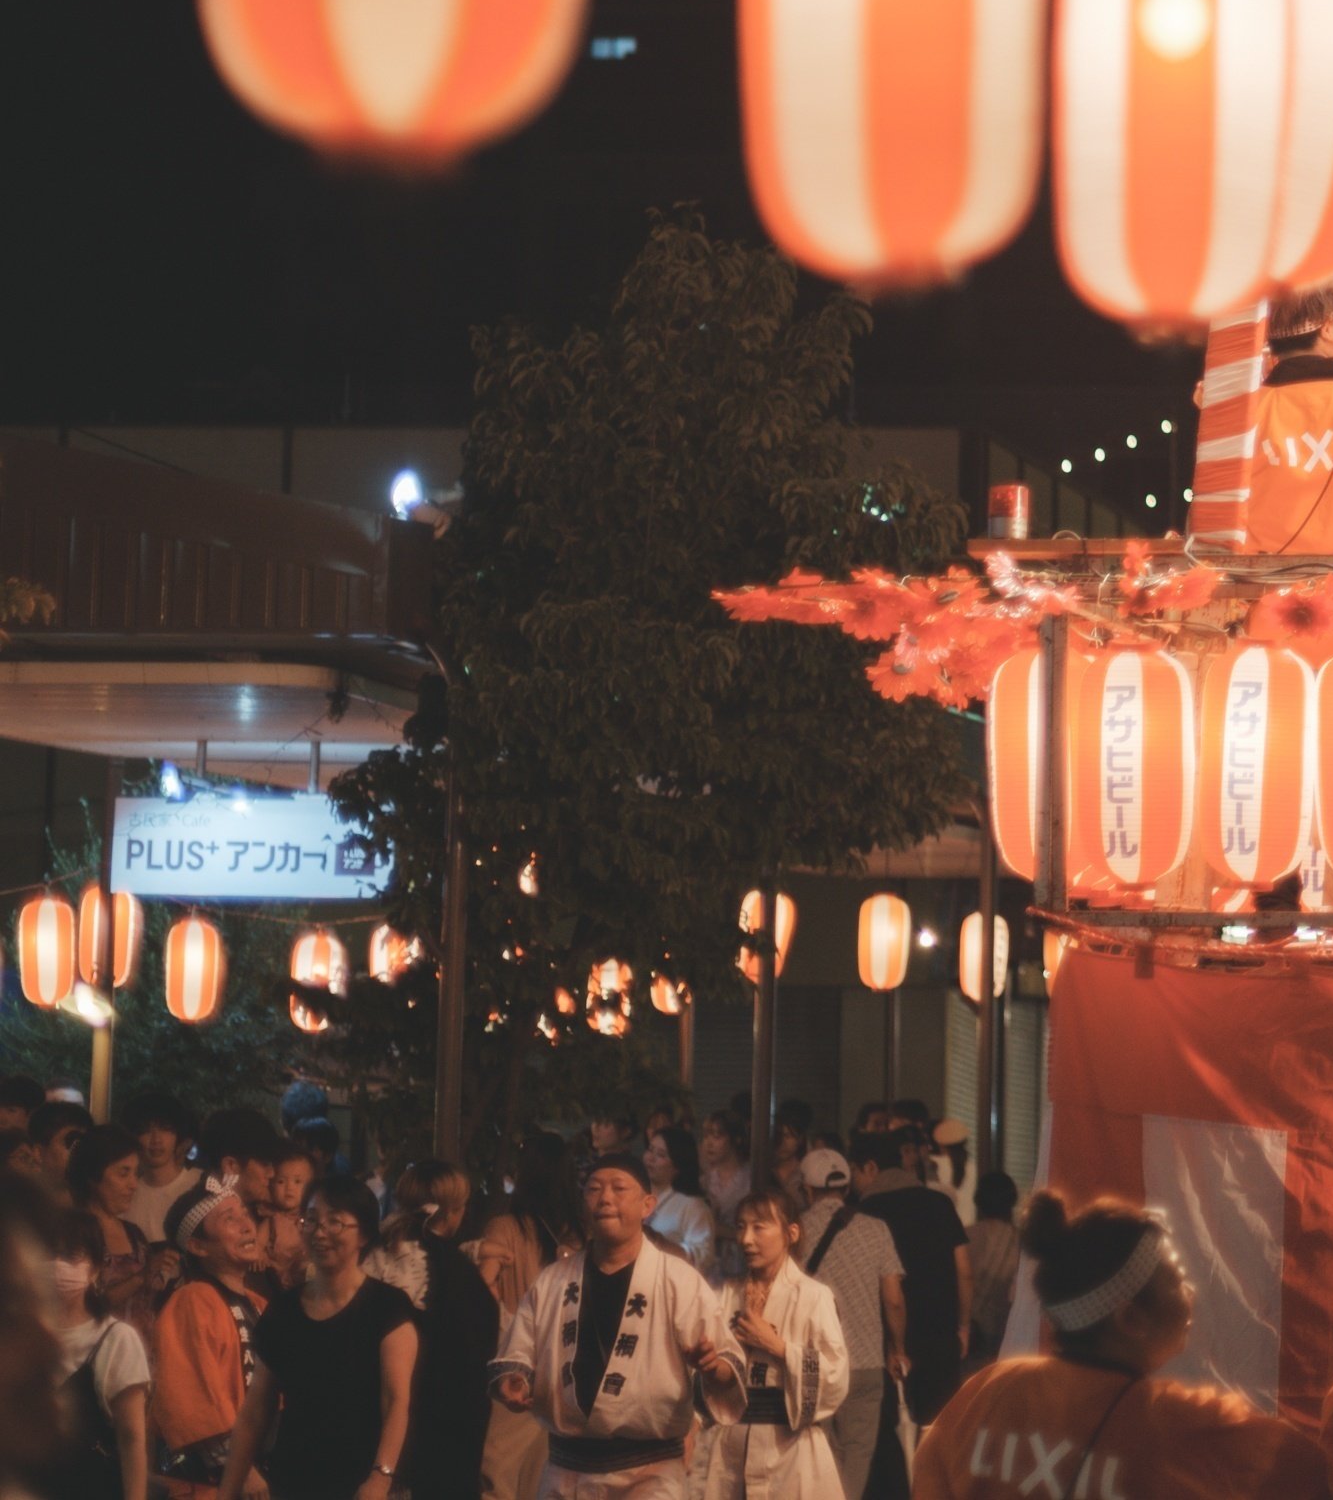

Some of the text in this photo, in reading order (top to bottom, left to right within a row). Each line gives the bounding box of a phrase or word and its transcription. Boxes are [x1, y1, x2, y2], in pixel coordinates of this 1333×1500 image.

[1104, 685, 1138, 859] アサヒビール
[1223, 681, 1263, 856] アサヒビール
[969, 1429, 1126, 1500] LIXIL
